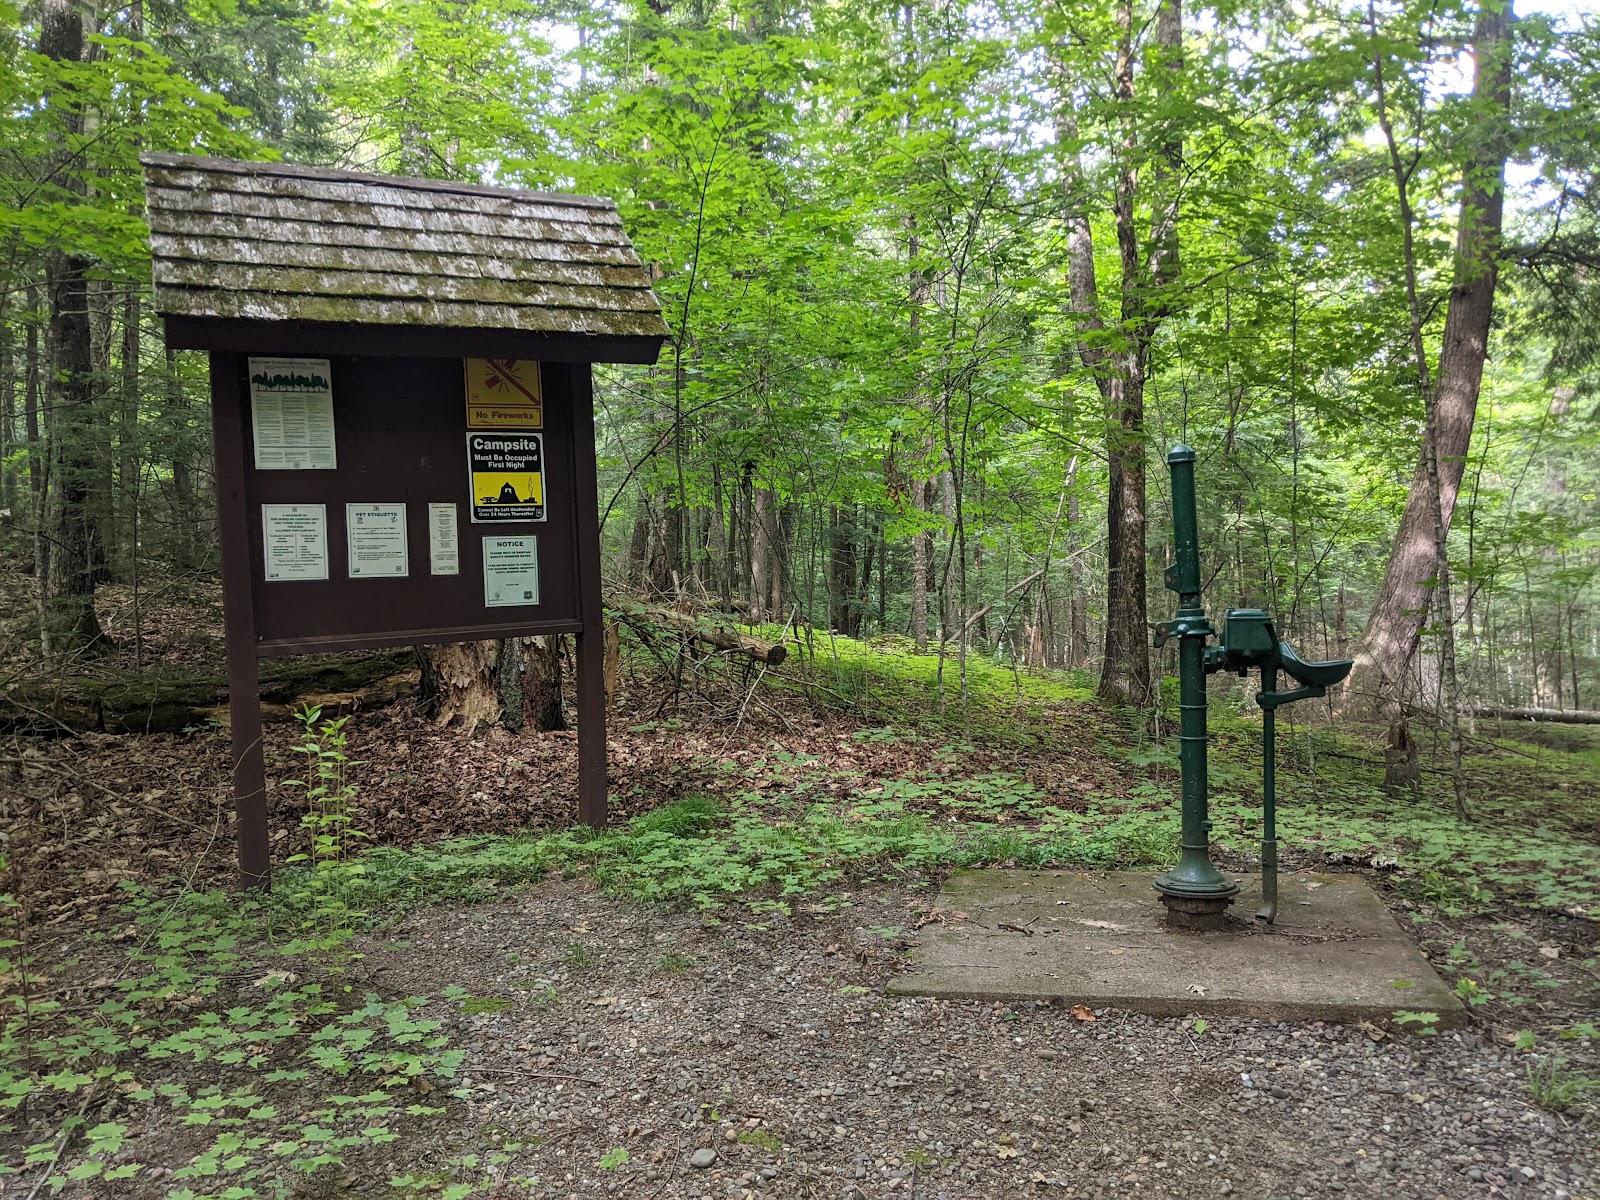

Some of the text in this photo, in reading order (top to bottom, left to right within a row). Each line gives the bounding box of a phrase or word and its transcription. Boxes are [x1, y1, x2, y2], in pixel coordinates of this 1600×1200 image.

[476, 411, 534, 420] No Fireworks
[473, 437, 537, 453] Campsite
[504, 454, 538, 462] Occupied
[505, 461, 525, 470] Night
